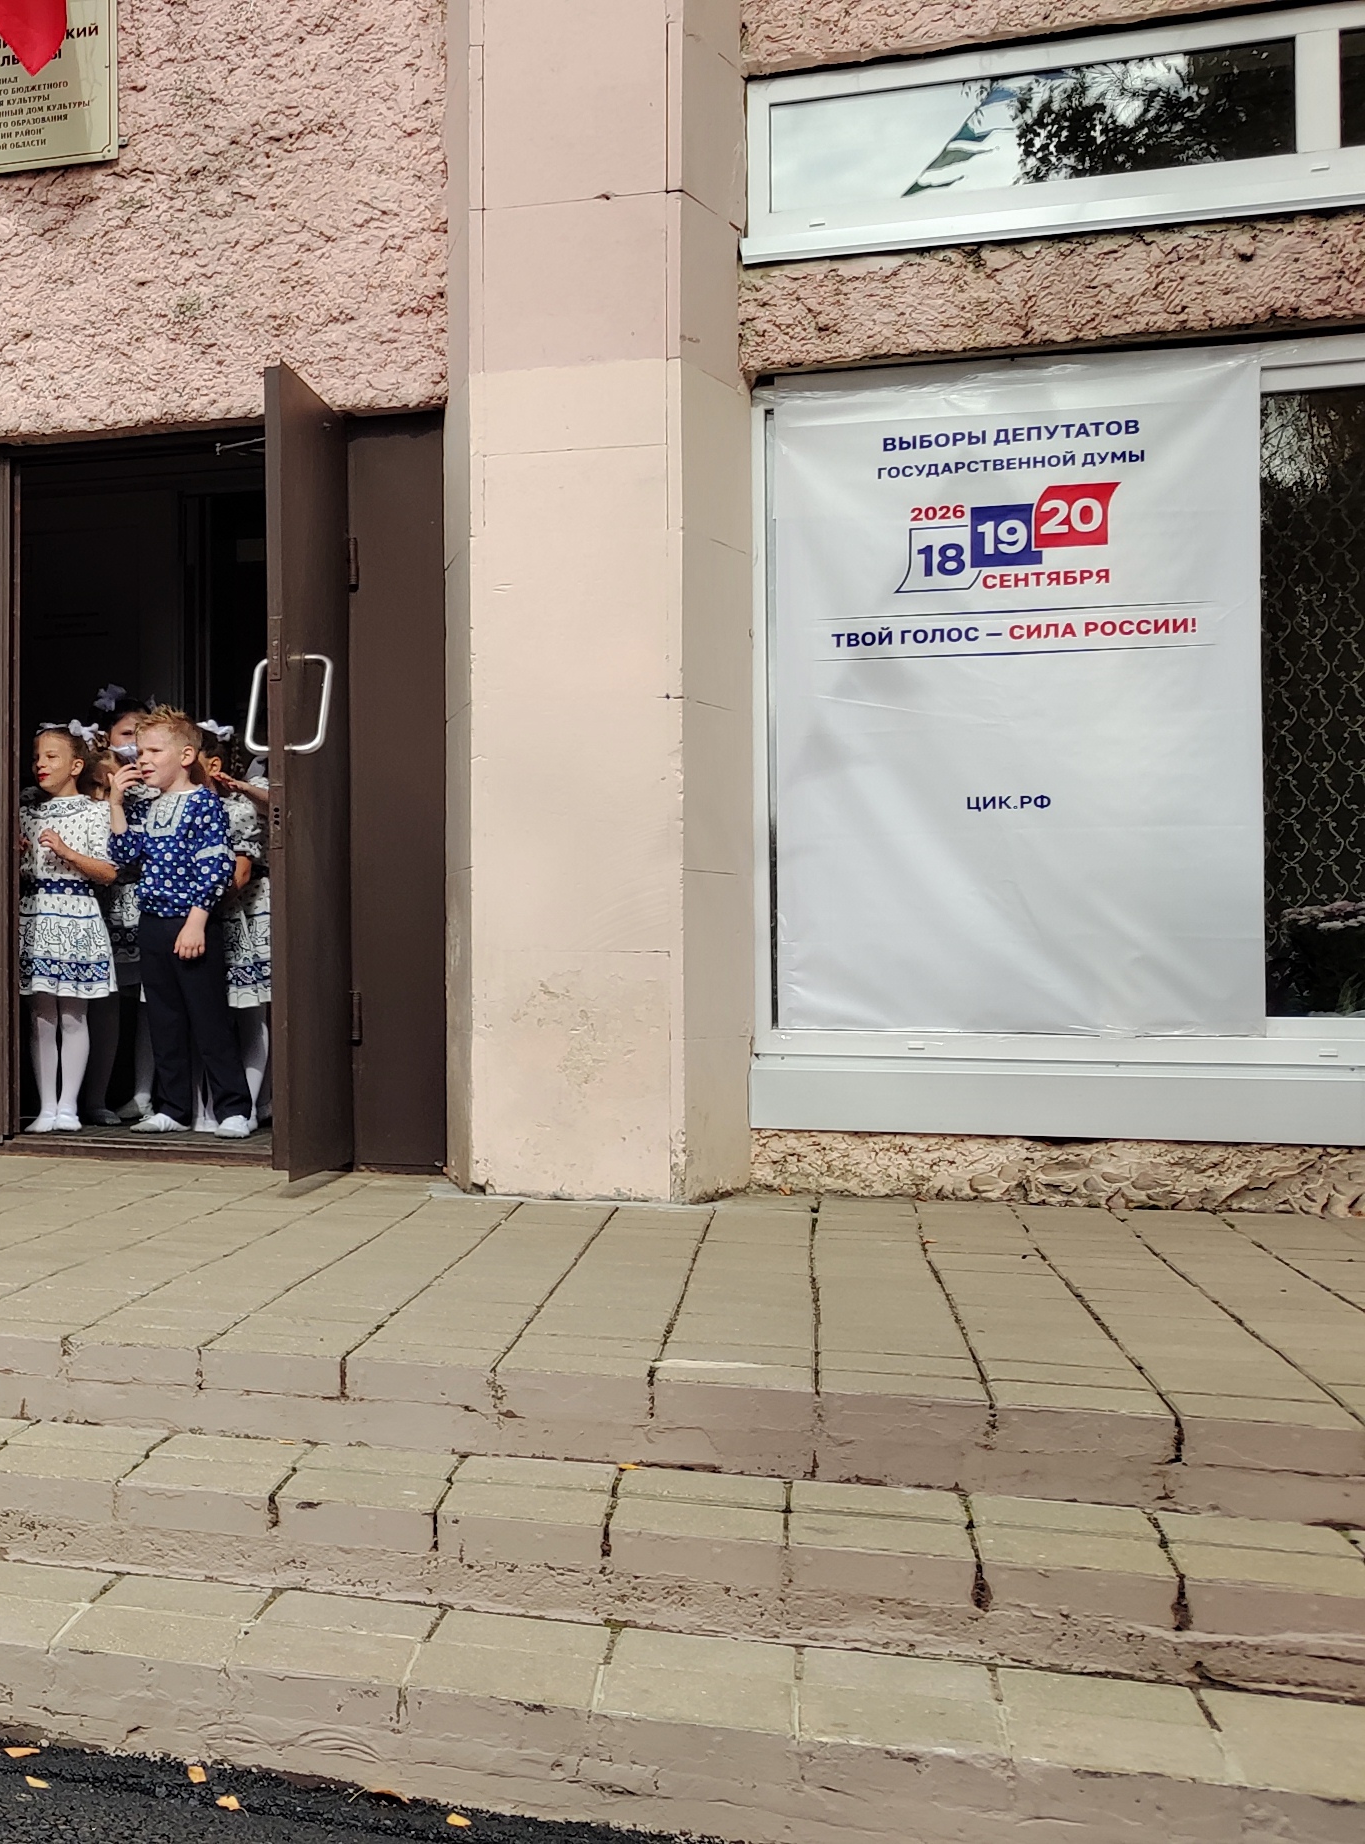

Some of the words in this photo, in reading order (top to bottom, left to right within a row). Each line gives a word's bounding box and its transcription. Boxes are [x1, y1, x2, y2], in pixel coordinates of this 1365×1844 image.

[11, 80, 68, 95] БЮДЖЕТНОГО
[6, 94, 50, 107] КУЛЬТУРЫ
[26, 105, 44, 115] ДОМ
[11, 114, 68, 128] ОБРАЗОВАНИЯ
[10, 138, 47, 149] ОБЛАСТИ
[882, 429, 988, 453] ВЫБОРЫ
[993, 419, 1141, 447] ДЕПУТАТОВ
[877, 450, 1077, 480] ГОСУДАРСТВЕННОЙ
[1082, 449, 1146, 469] ДУМЫ
[909, 504, 966, 522] 2026
[917, 542, 966, 578] 18
[977, 518, 1028, 555] 19
[1039, 497, 1103, 534] 20
[981, 568, 1110, 590] СЕНТЯБРЯ
[831, 625, 893, 649] ТВОЙ
[900, 625, 980, 646] ГОЛОС
[1008, 619, 1078, 642] СИЛА
[1083, 617, 1198, 637] РОССИИ!
[966, 794, 1052, 813] ЦИК.РФ
